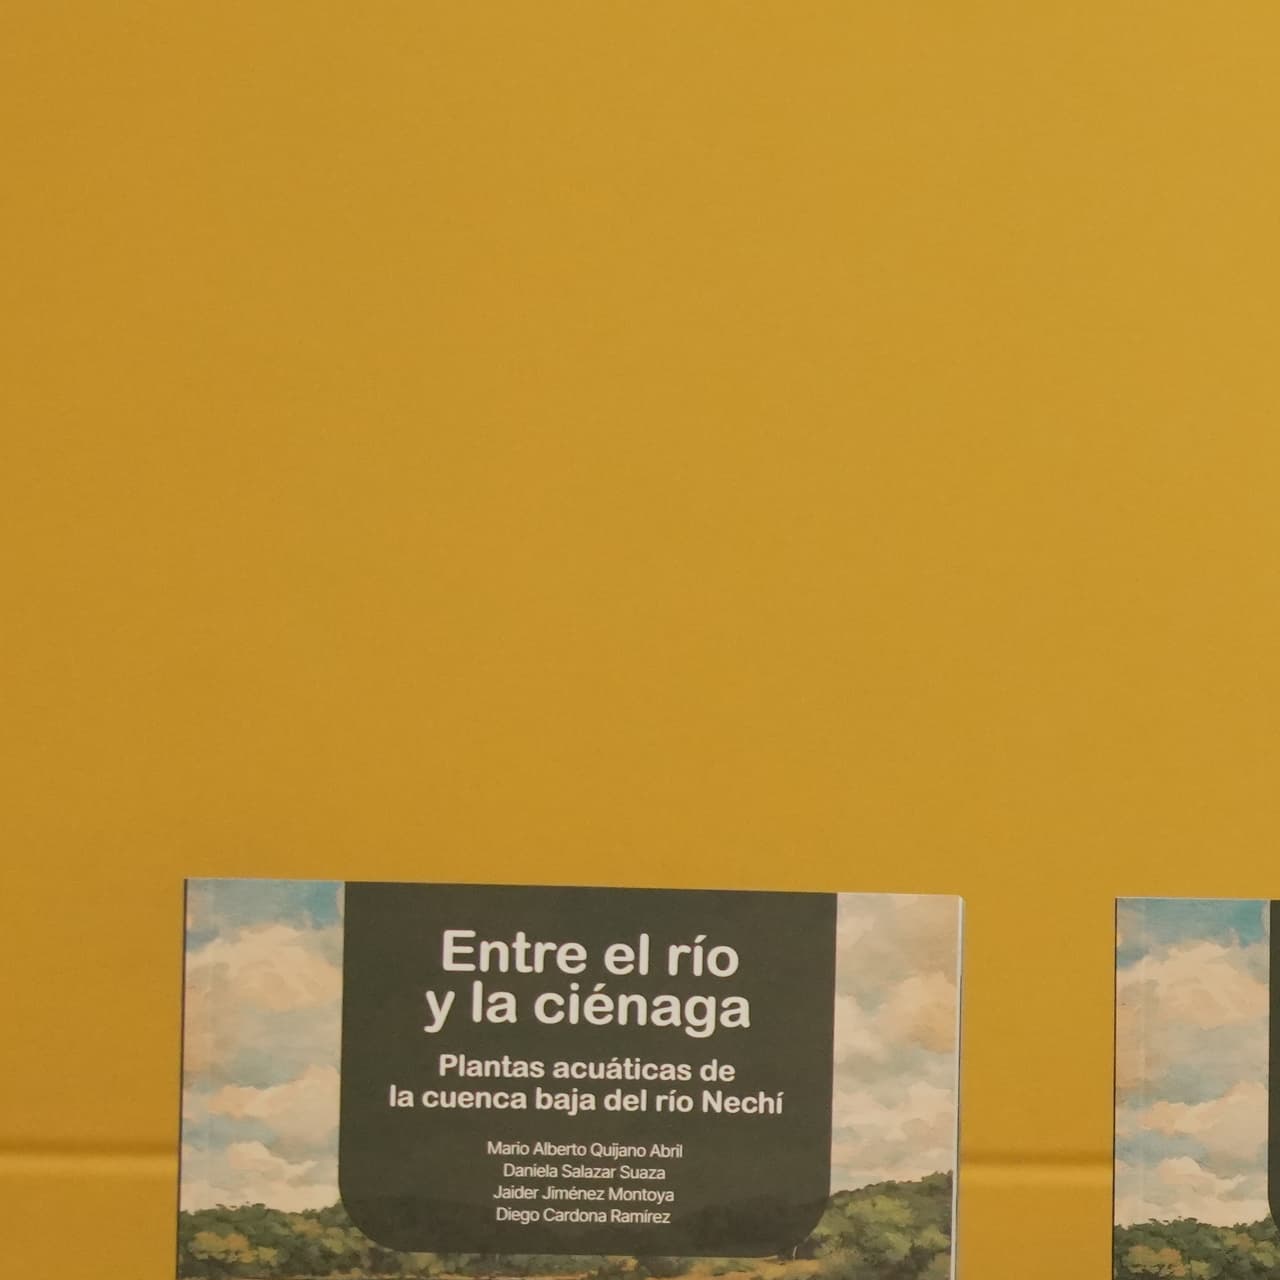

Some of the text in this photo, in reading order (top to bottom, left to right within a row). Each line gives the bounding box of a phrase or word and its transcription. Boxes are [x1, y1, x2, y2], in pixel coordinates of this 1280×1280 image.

[442, 929, 739, 978] Entre el río
[423, 980, 751, 1039] y la ciénaga
[439, 1053, 736, 1082] Plantas acuáticas de
[389, 1084, 785, 1117] la cuenca baja del río Nechí
[487, 1140, 683, 1161] Mario Alberto Quijano Abril
[503, 1162, 666, 1180] Daniela Salazar Suaza
[492, 1184, 675, 1205] Jaider Jiménez Montoya
[495, 1206, 671, 1225] Diego Cardona Ramírez
